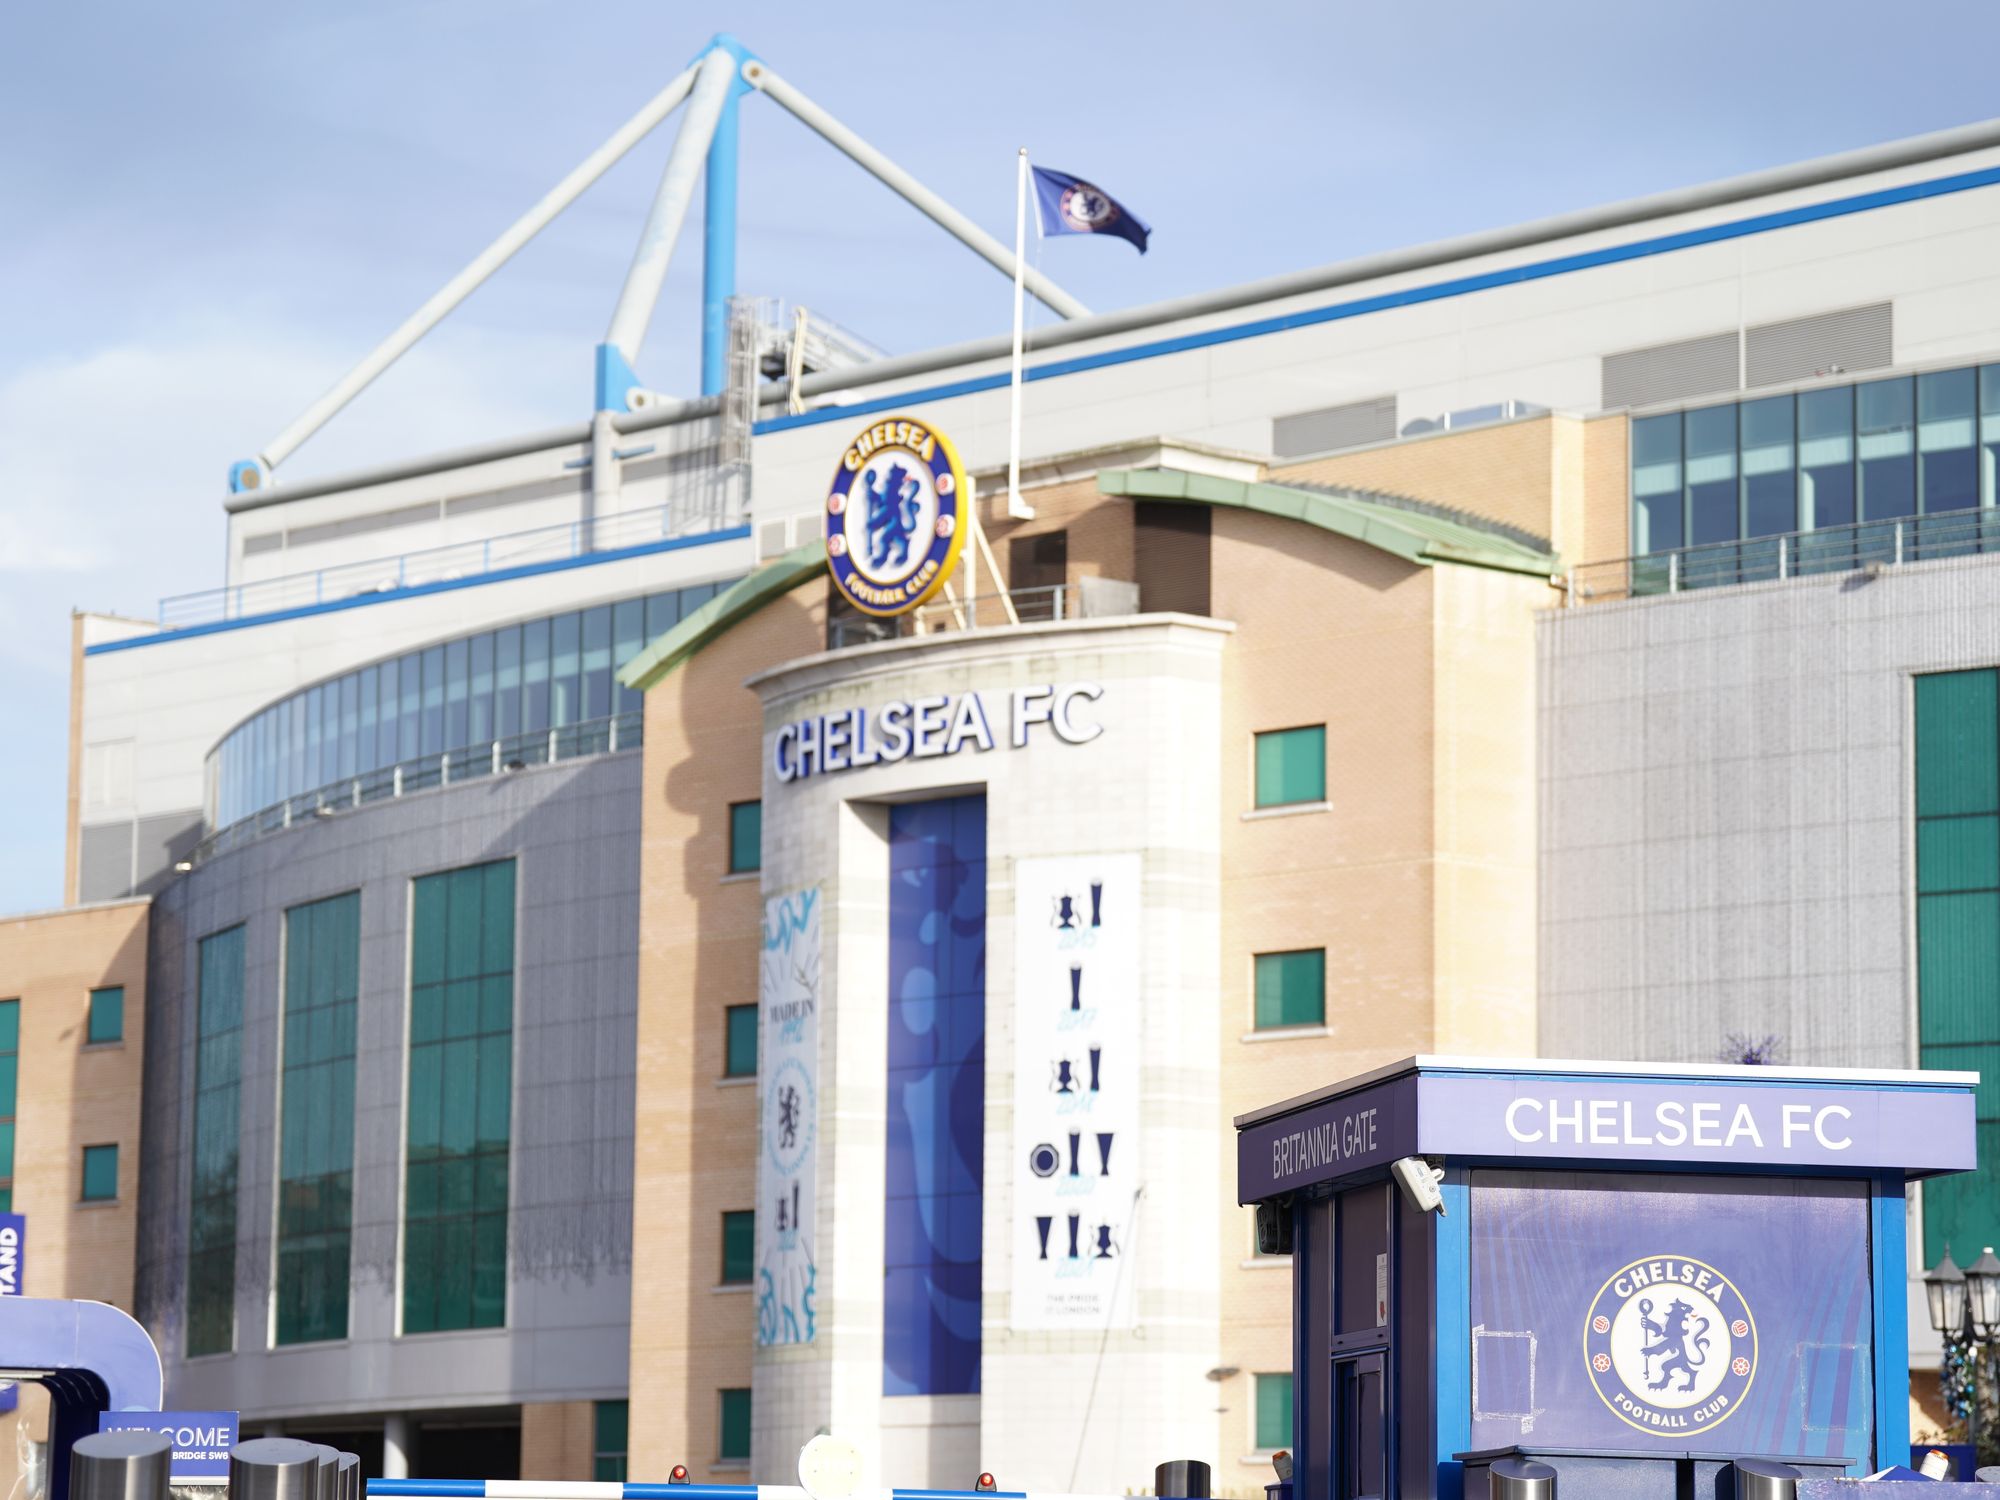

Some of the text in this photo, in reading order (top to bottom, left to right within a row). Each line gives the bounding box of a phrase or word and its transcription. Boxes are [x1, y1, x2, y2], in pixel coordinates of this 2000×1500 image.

[844, 421, 937, 471] CHELSEA
[773, 682, 1104, 783] CHELSEA FC
[1273, 1108, 1377, 1180] BRITANNIA GATE
[1505, 1097, 1853, 1151] CHELSEA FC
[1614, 1262, 1726, 1304] CHELSEA
[1614, 1392, 1729, 1428] FOOTBALL CLUB
[172, 1451, 229, 1460] BRIDGE SW6
